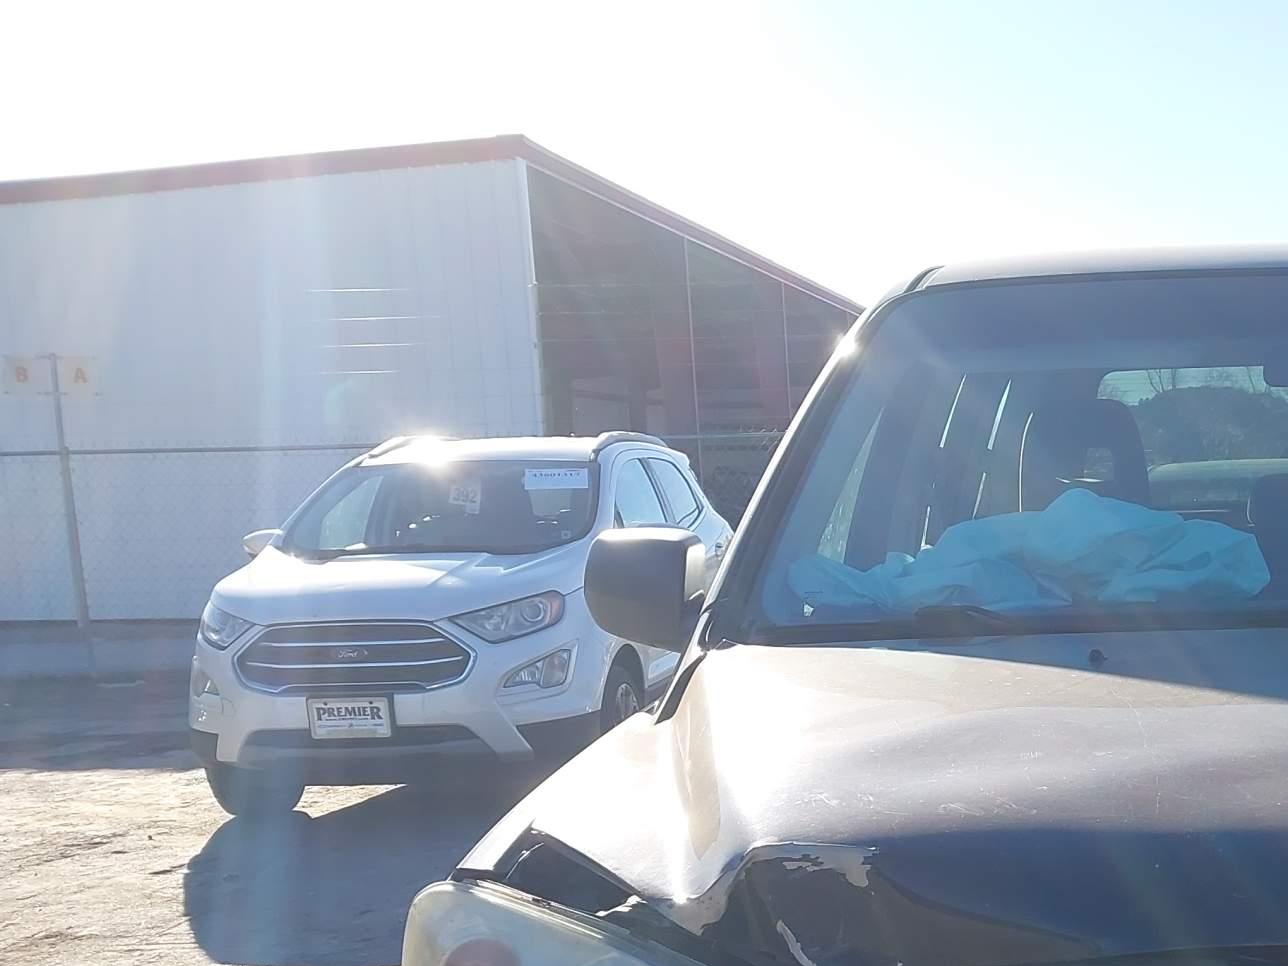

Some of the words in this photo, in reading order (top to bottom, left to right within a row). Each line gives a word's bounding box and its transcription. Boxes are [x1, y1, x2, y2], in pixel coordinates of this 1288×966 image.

[15, 366, 29, 383] B
[73, 367, 88, 384] A
[452, 487, 478, 504] 392
[315, 705, 384, 721] PREMIER
